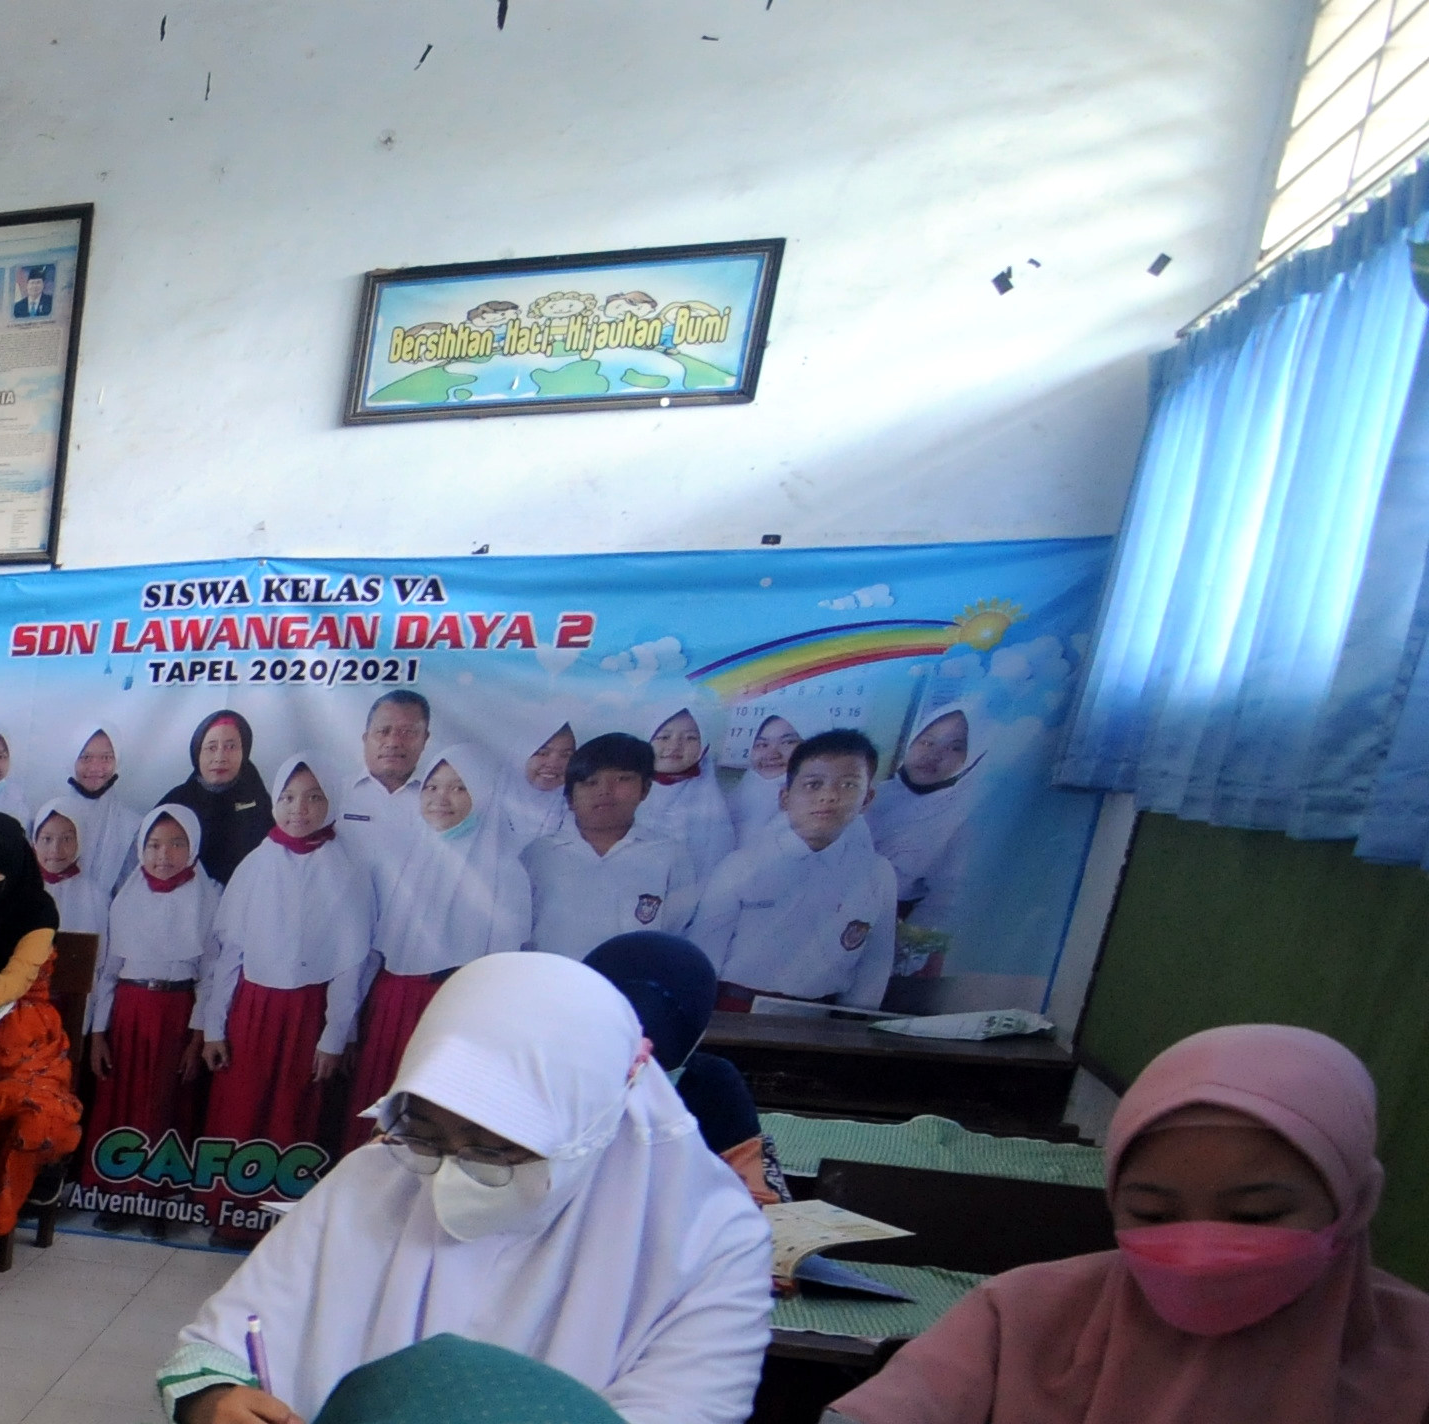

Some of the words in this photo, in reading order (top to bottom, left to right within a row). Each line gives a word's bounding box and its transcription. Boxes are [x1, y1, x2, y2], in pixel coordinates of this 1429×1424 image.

[672, 306, 731, 345] Bumi
[144, 578, 249, 609] SISWA
[261, 577, 382, 604] KELAS
[396, 577, 446, 604] VA
[11, 621, 99, 657] SDN
[111, 615, 381, 655] LAWANGAN
[394, 614, 538, 650] DAYA
[556, 614, 594, 649] 2
[150, 660, 238, 684] TAPEL
[250, 659, 419, 685] 2020/2021
[69, 1184, 210, 1225] Adventurous,
